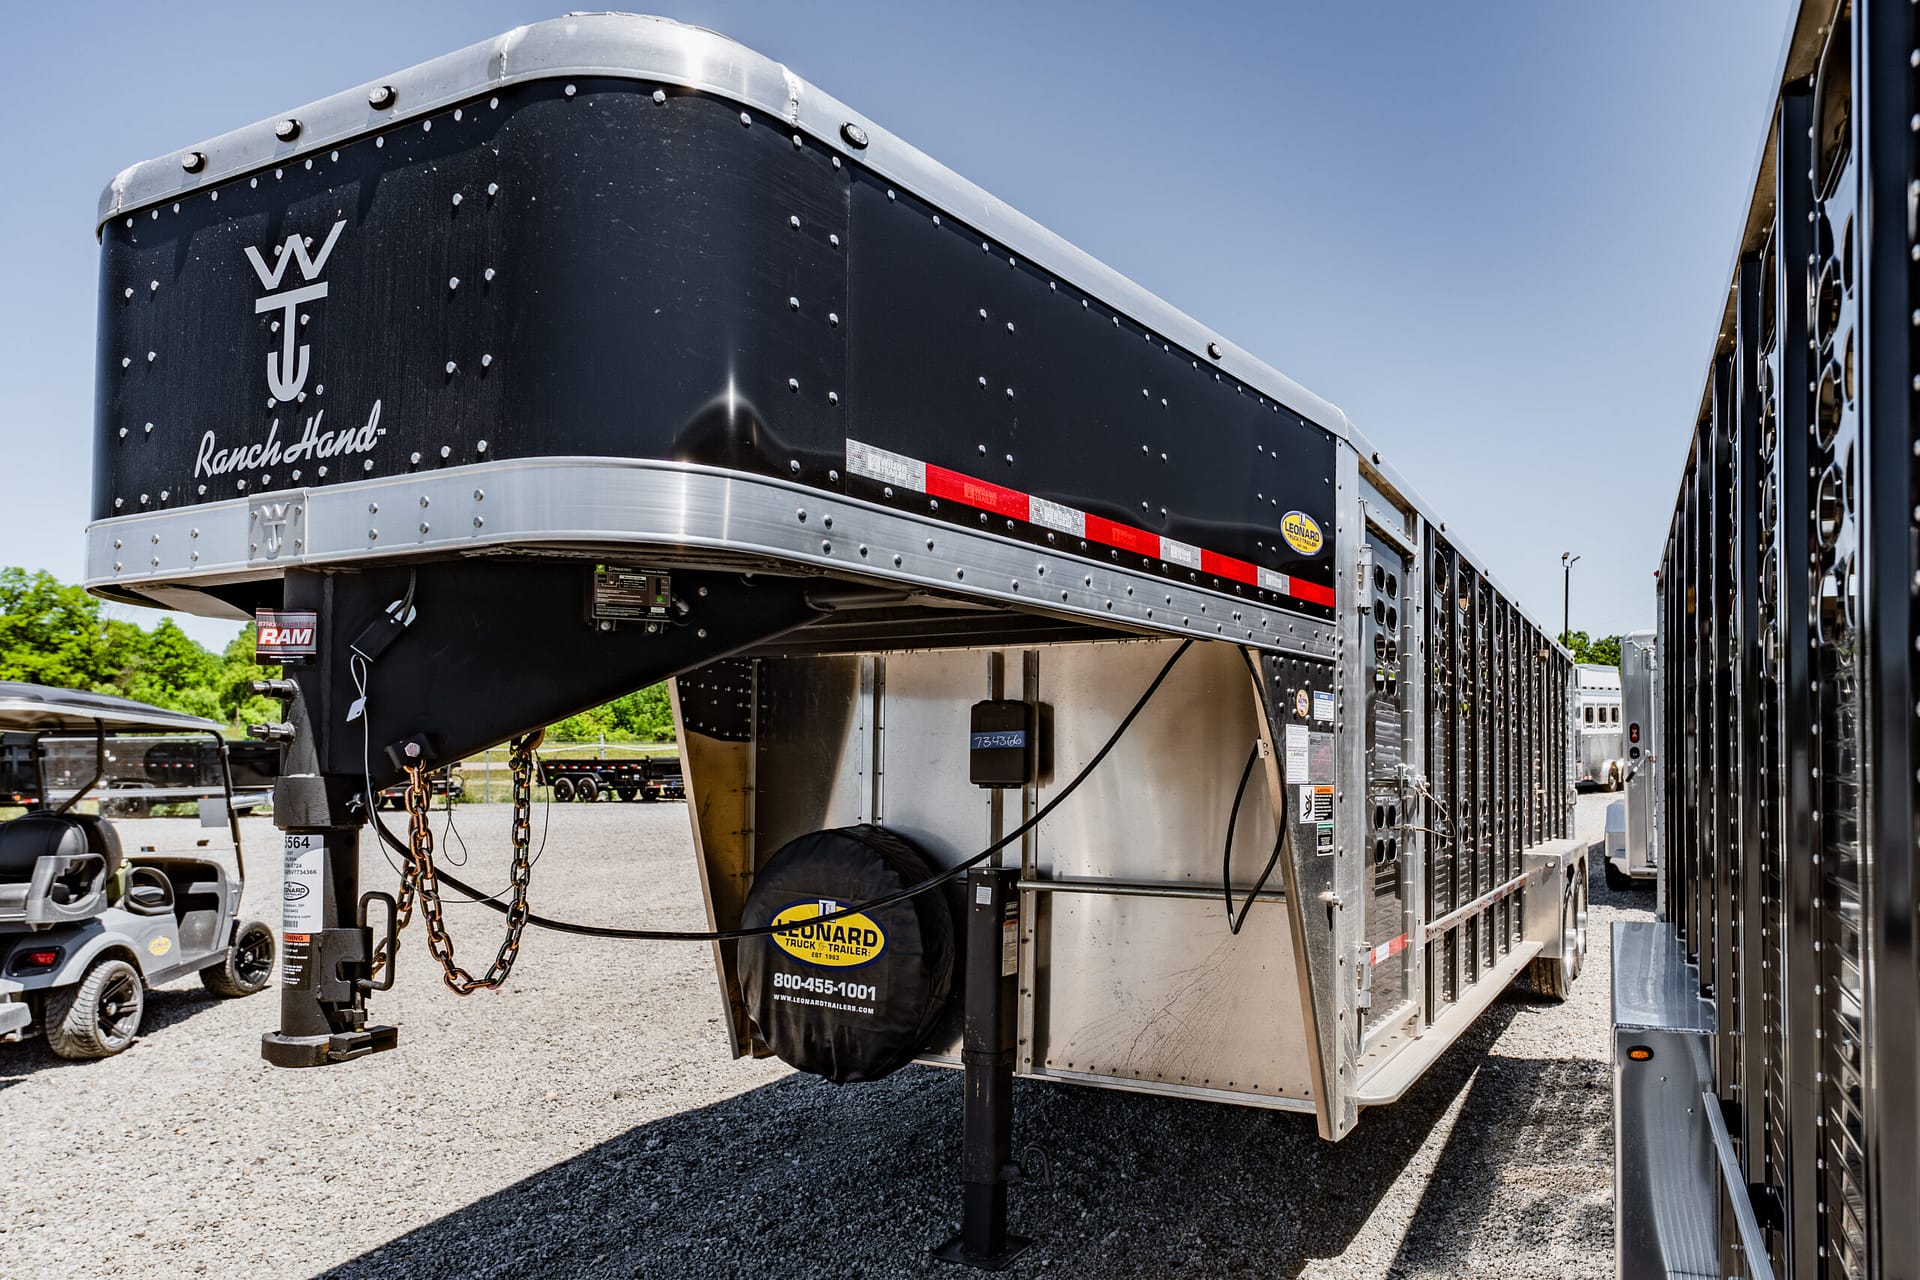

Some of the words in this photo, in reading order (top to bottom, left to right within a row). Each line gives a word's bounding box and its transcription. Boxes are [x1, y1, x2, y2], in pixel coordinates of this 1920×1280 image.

[194, 418, 282, 478] Ranch
[282, 399, 382, 463] Hand
[1285, 521, 1320, 542] LEONARD
[258, 628, 313, 645] RAM
[974, 734, 1022, 748] 734366
[784, 938, 816, 950] TRUCK
[827, 943, 867, 957] TRAILER
[773, 972, 876, 1001] 800-455-1001
[773, 993, 874, 1015] WWW.LEONARDTRAILERS.COM
